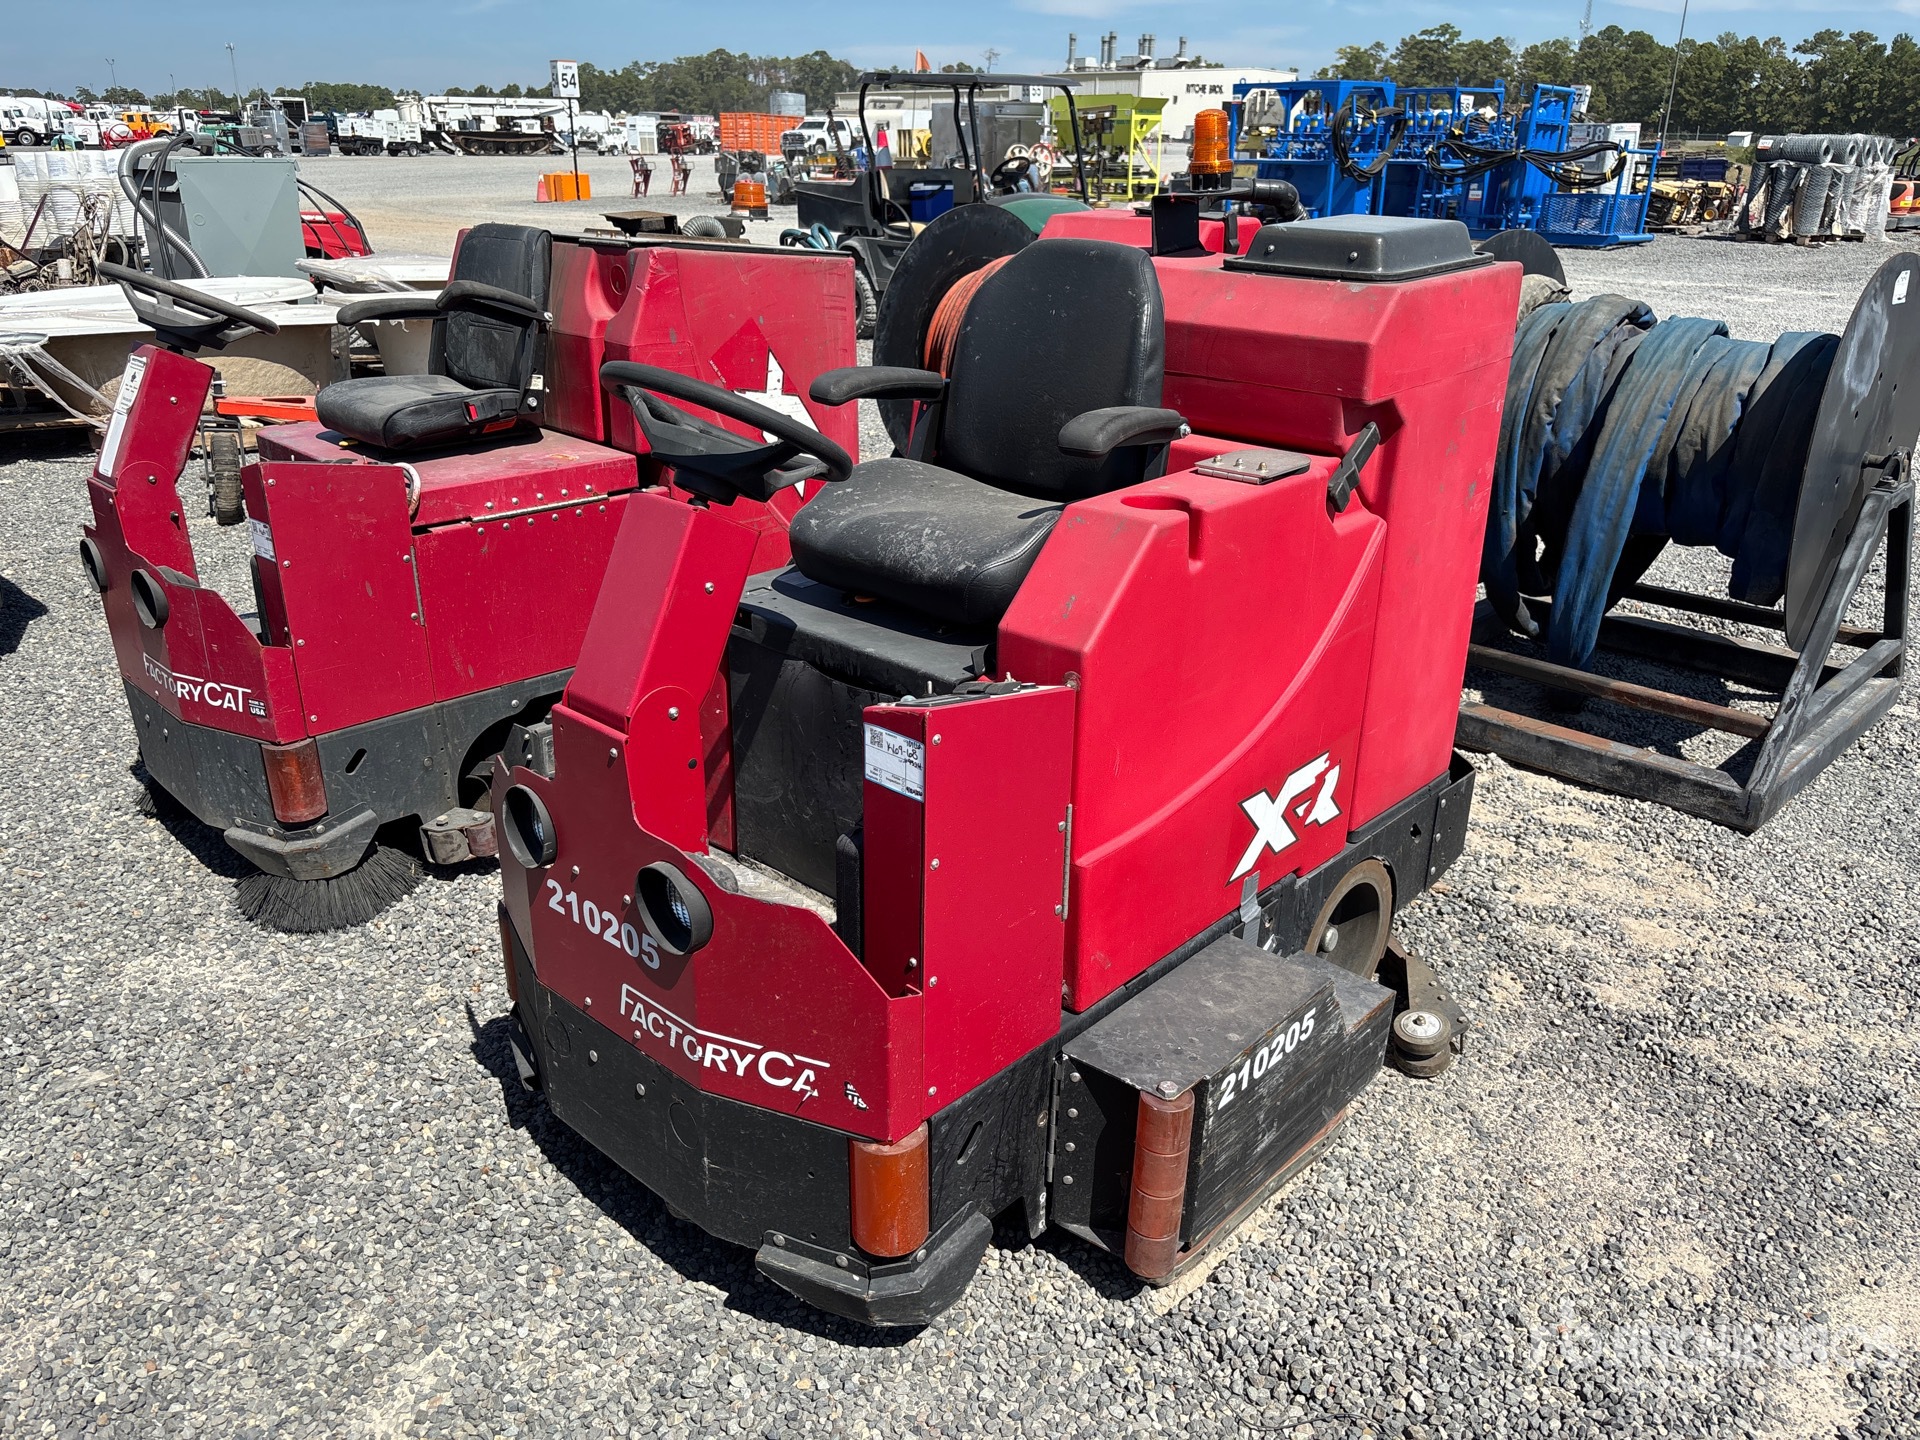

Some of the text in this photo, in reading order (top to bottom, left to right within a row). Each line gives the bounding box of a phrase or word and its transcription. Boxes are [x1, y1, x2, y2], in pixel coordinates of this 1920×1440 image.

[561, 72, 577, 89] 54
[1186, 83, 1207, 94] RITCHIE
[250, 706, 266, 717] USA
[546, 878, 661, 970] 210205
[1217, 1007, 1316, 1111] 210205
